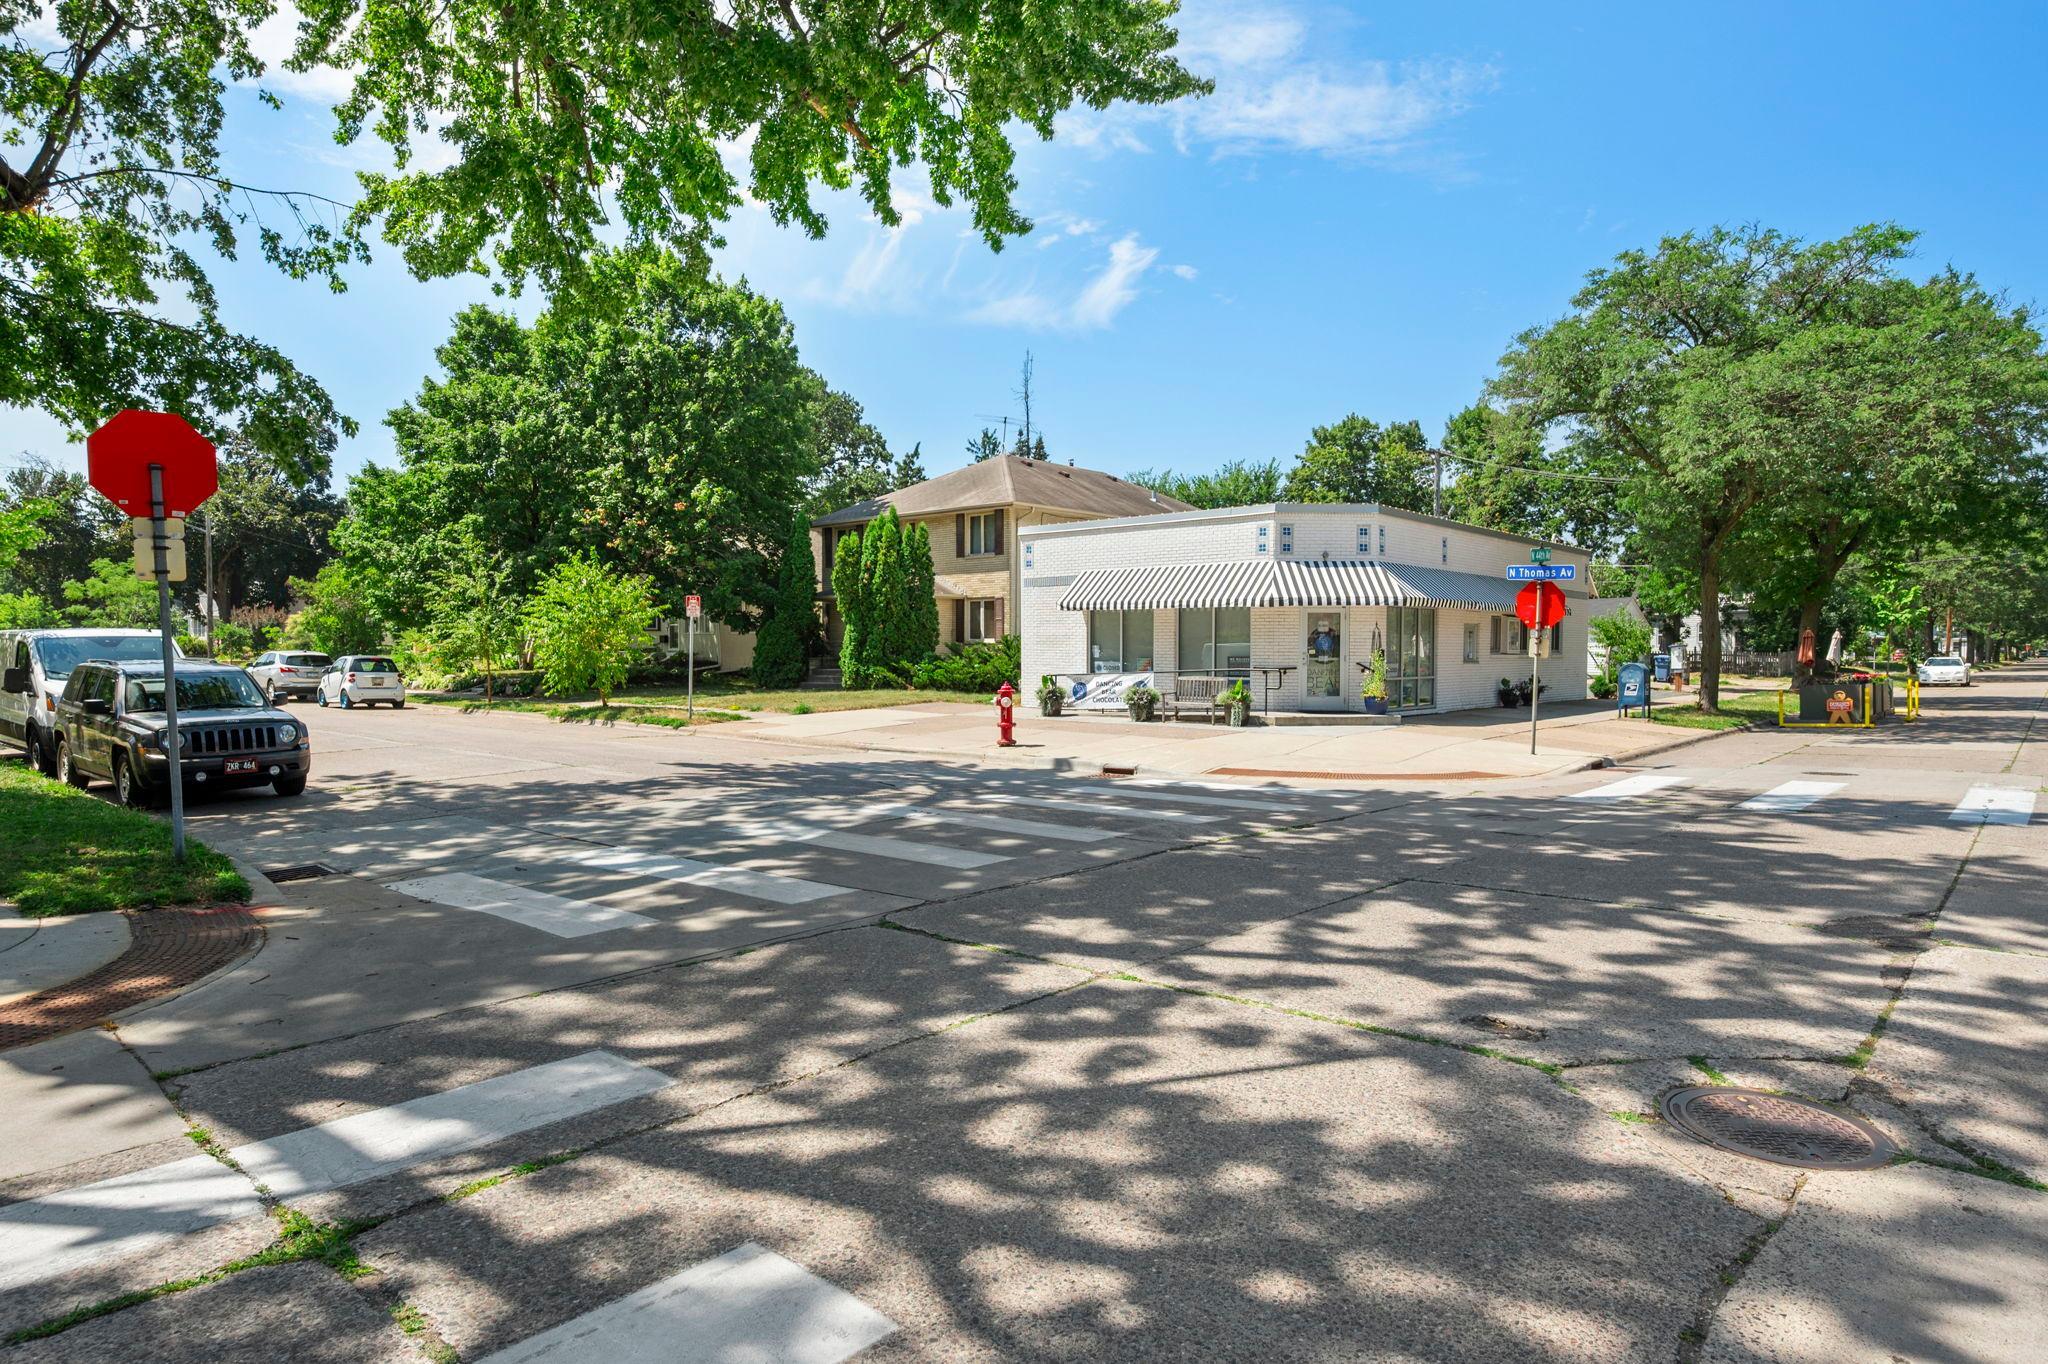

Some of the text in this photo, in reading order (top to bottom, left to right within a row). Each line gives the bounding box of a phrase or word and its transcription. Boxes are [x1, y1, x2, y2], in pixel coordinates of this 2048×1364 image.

[1509, 568, 1573, 578] N Thomas Av
